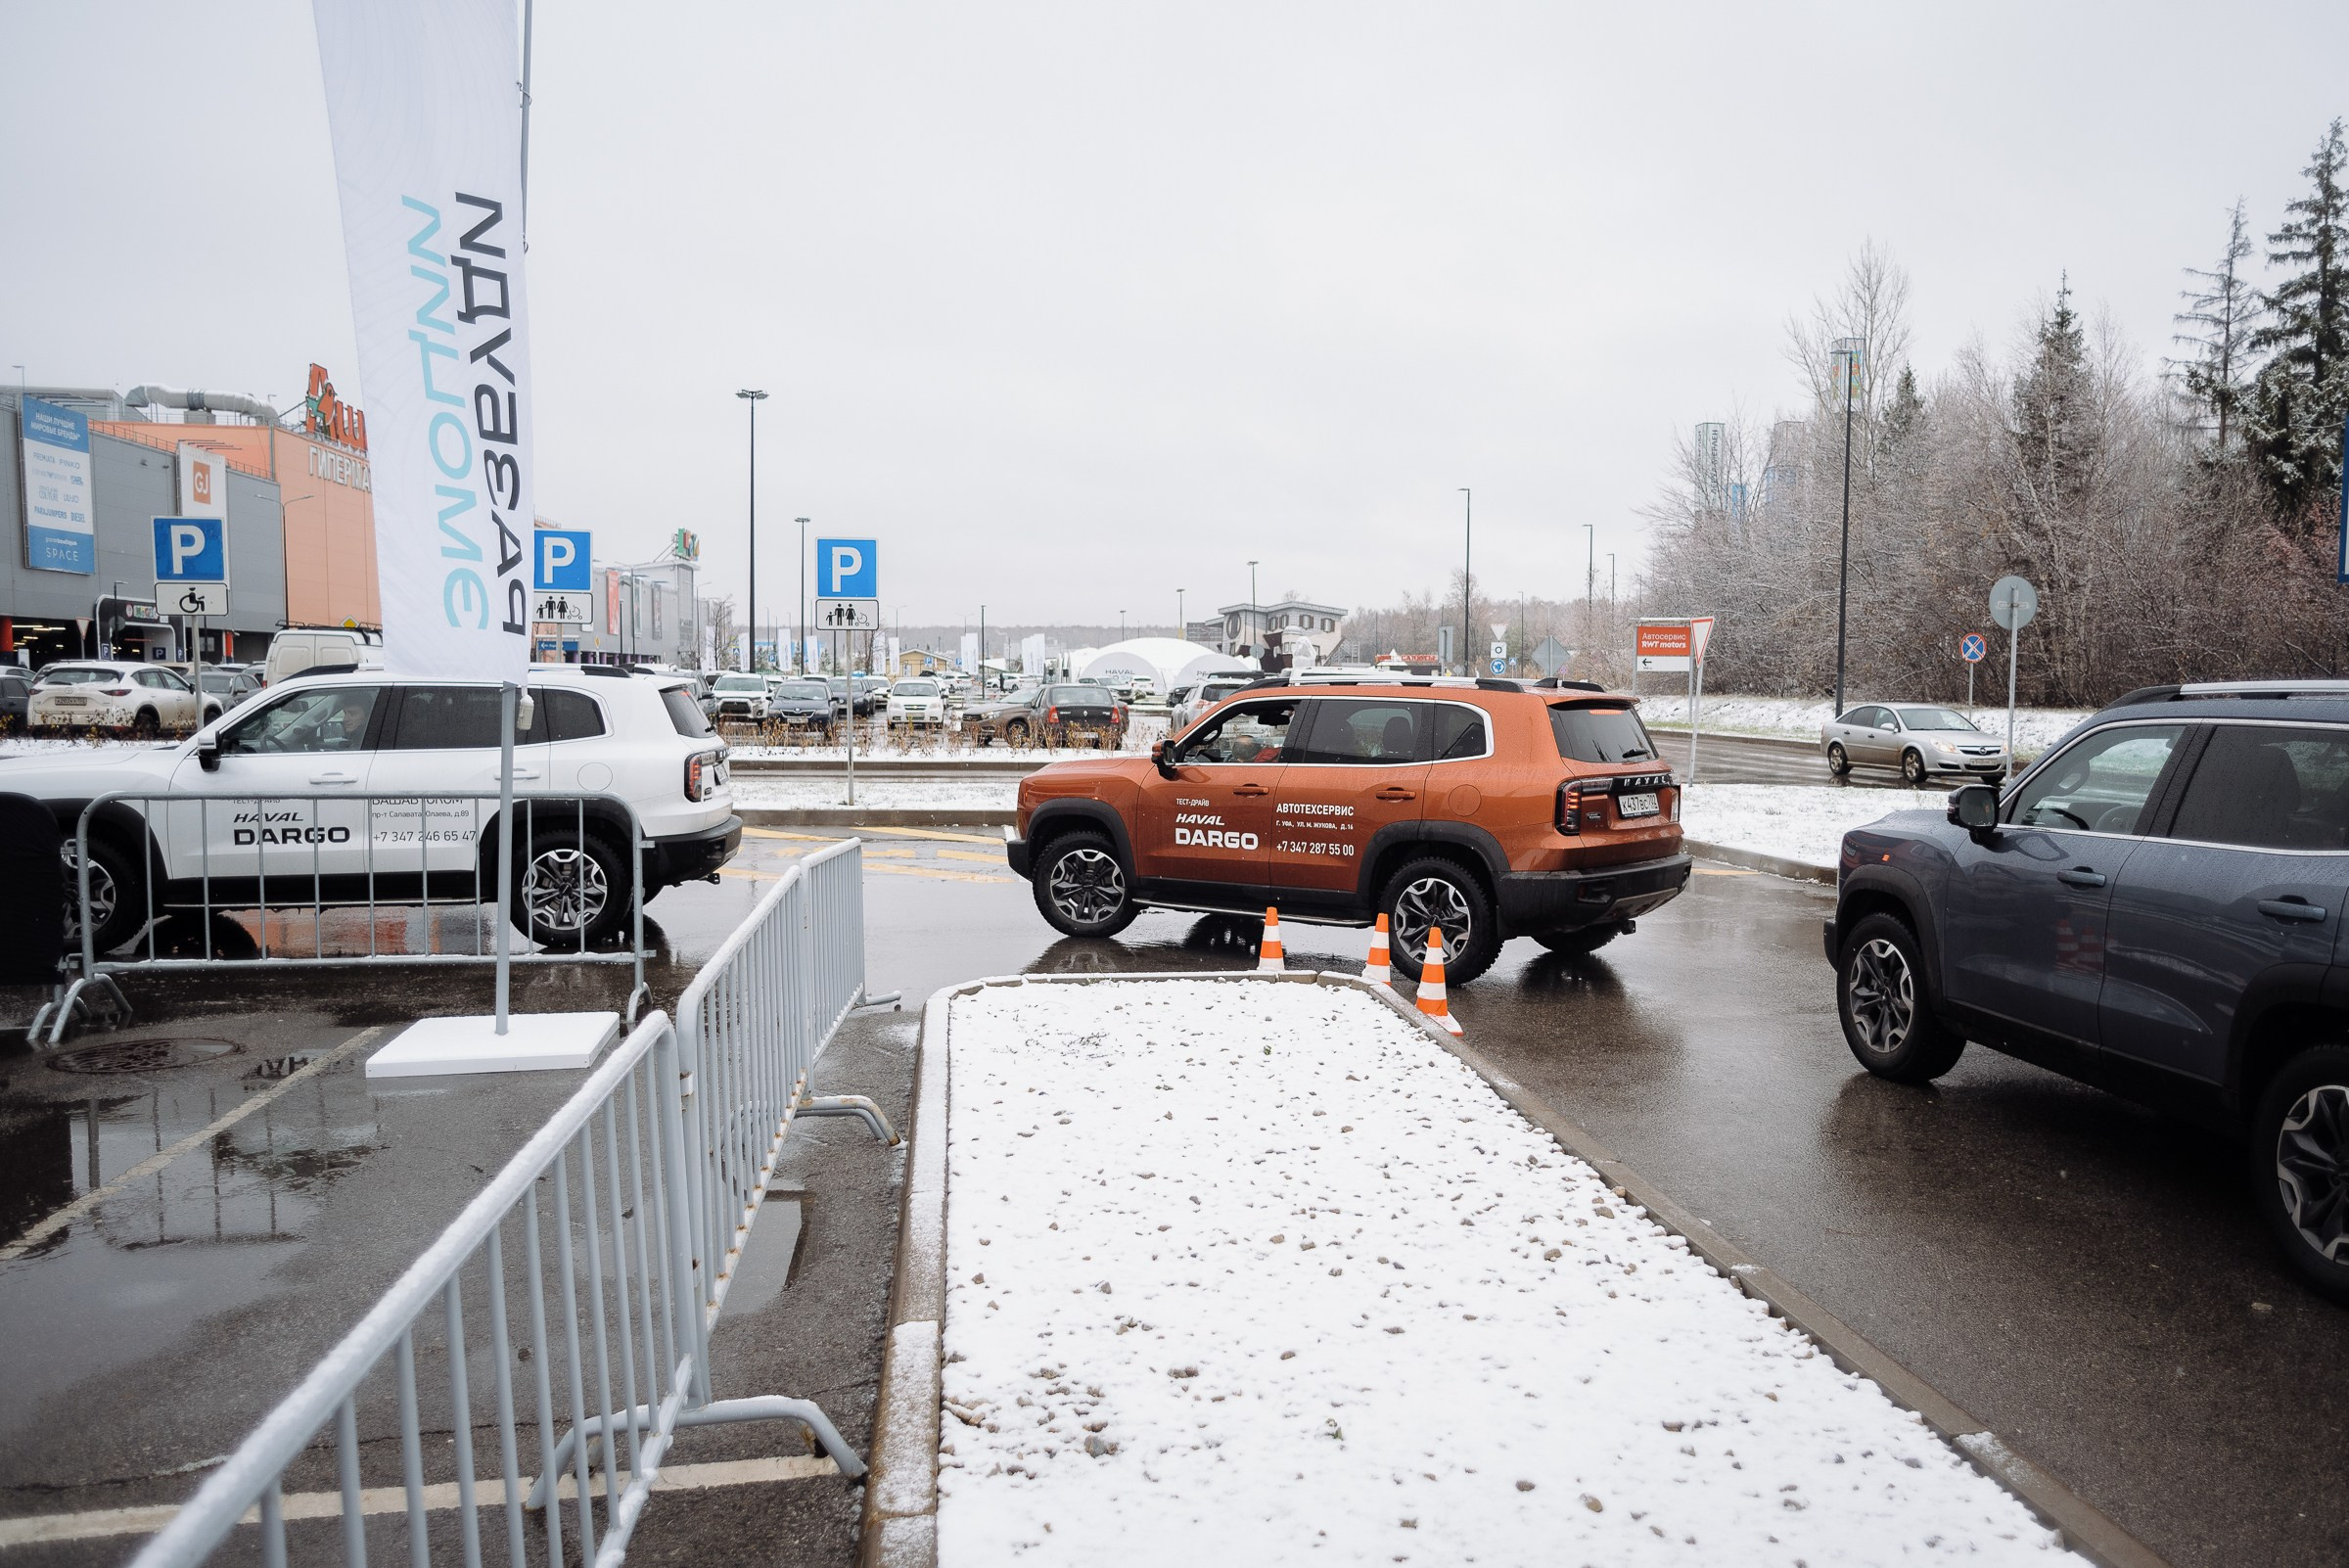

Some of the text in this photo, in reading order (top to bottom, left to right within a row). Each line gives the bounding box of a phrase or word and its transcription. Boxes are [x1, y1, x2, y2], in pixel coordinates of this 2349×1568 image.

[59, 458, 80, 469] PINKO
[194, 472, 208, 495] GJ
[45, 547, 79, 561] SPACE
[170, 525, 206, 575] P
[544, 536, 576, 584] P
[832, 546, 862, 593] P
[1641, 632, 1686, 641] Автосервис
[1624, 776, 1665, 787] HAVAL
[1275, 803, 1355, 816] АВТОТЕХСЕРВИС
[233, 812, 303, 822] HAVAL
[1175, 813, 1225, 826] HAVAL
[233, 826, 350, 846] DARGO
[373, 831, 388, 842] +7
[392, 831, 414, 842] 347
[443, 830, 459, 841] 65
[1174, 827, 1259, 851] DARGO
[1276, 841, 1355, 856] +7 347 287 55 00
